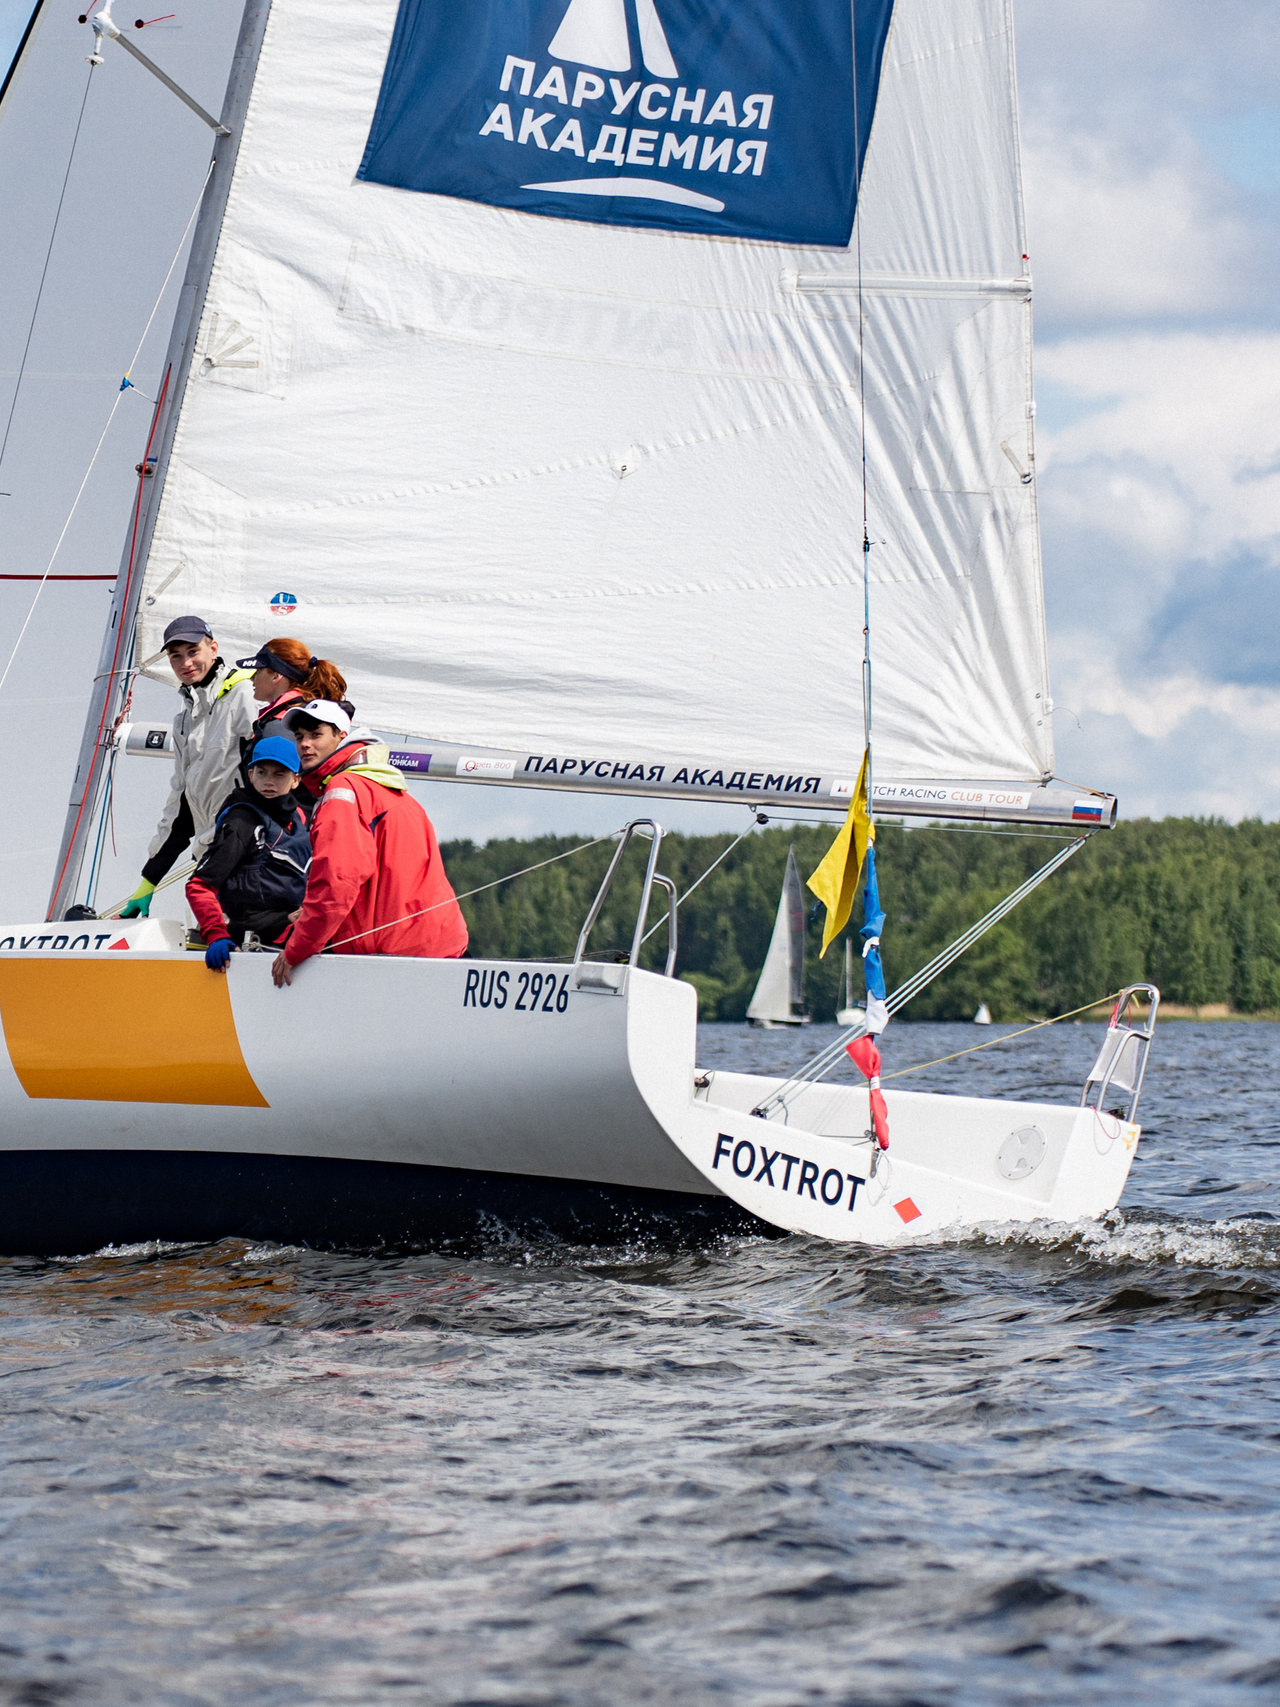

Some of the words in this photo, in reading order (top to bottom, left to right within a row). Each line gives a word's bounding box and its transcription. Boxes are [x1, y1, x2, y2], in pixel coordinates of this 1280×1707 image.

[499, 54, 774, 130] ПАРУСНАЯ
[478, 102, 768, 176] АКАДЕМИЯ
[494, 761, 511, 770] 800
[523, 755, 665, 782] ПАРУСНАЯ
[672, 767, 821, 794] АКАДЕМИЯ
[867, 785, 897, 796] TCH
[900, 787, 947, 800] RACING
[951, 791, 983, 802] CLUB
[988, 793, 1023, 804] TOUR
[463, 969, 510, 1009] RUS
[514, 972, 569, 1013] 2926
[712, 1132, 866, 1212] FOXTROT
